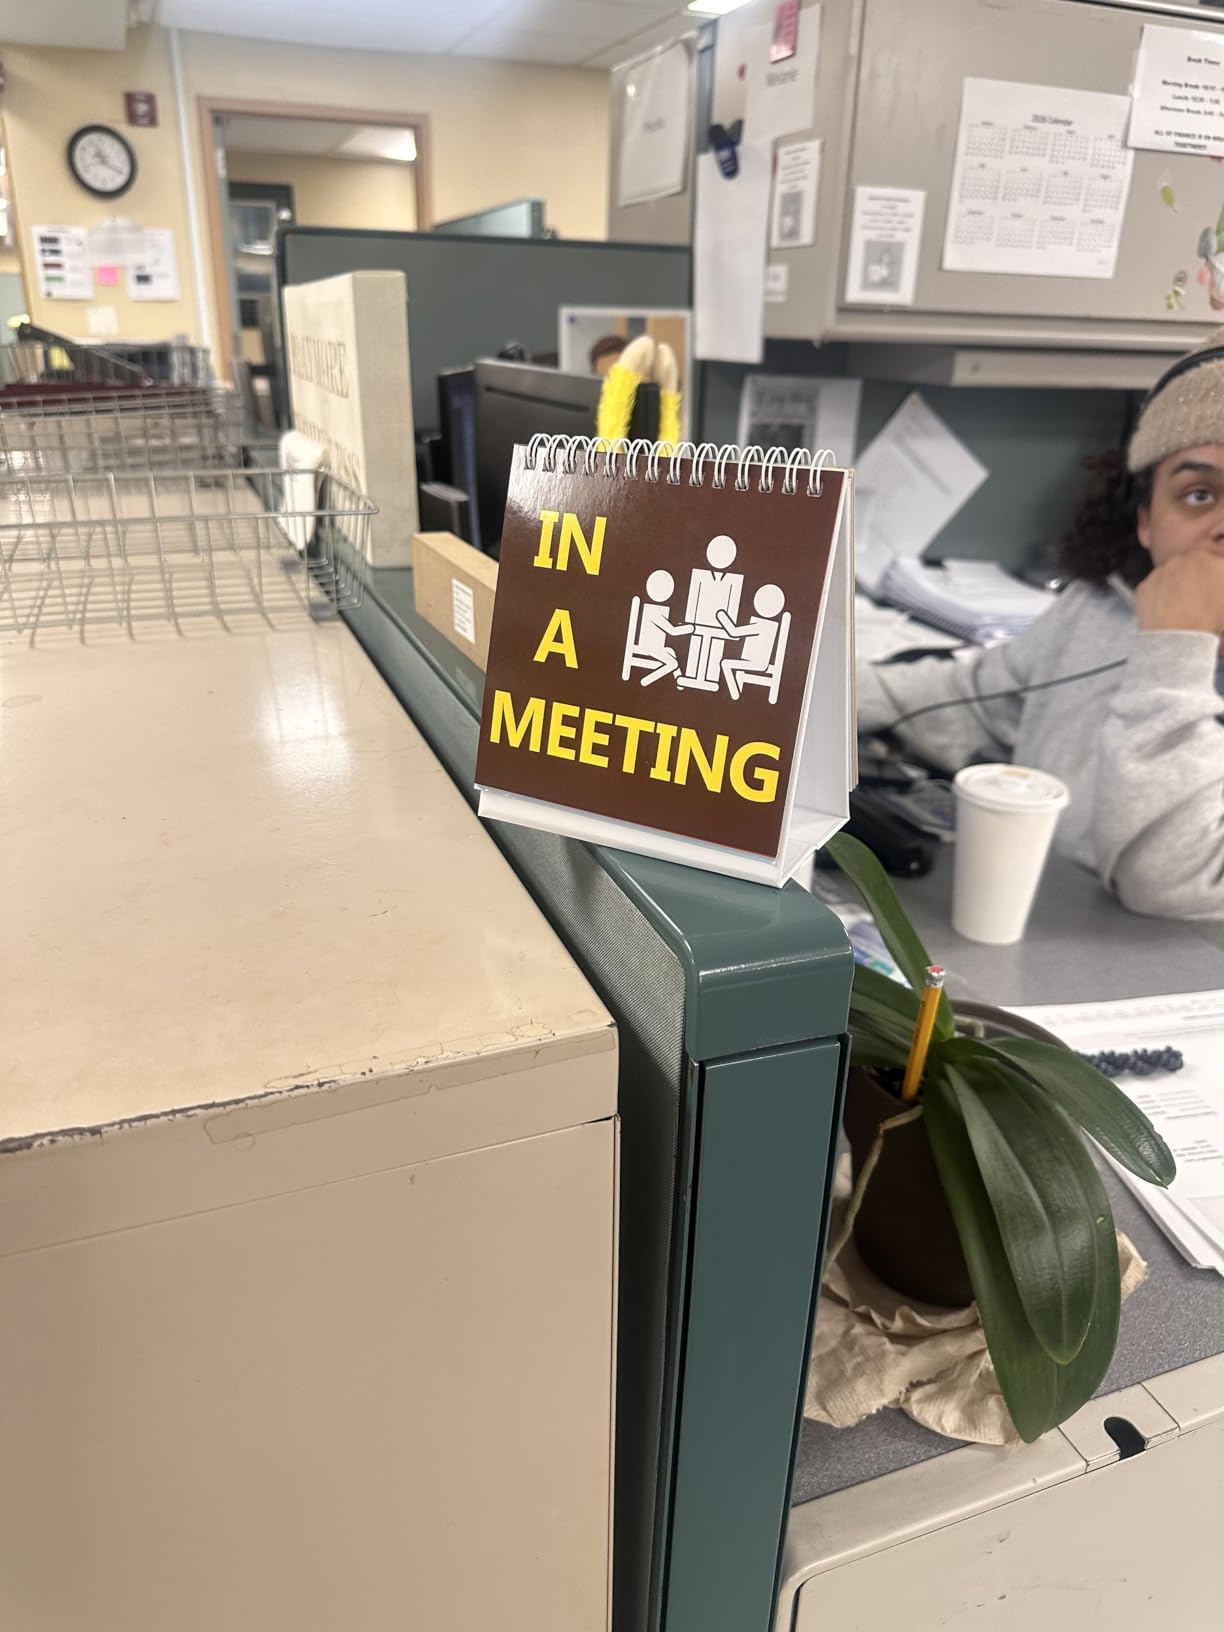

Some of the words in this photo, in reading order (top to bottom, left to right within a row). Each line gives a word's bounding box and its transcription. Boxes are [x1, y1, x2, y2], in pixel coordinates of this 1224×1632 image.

[533, 510, 607, 576] IN
[533, 608, 579, 669] A
[489, 689, 781, 803] MEETING
